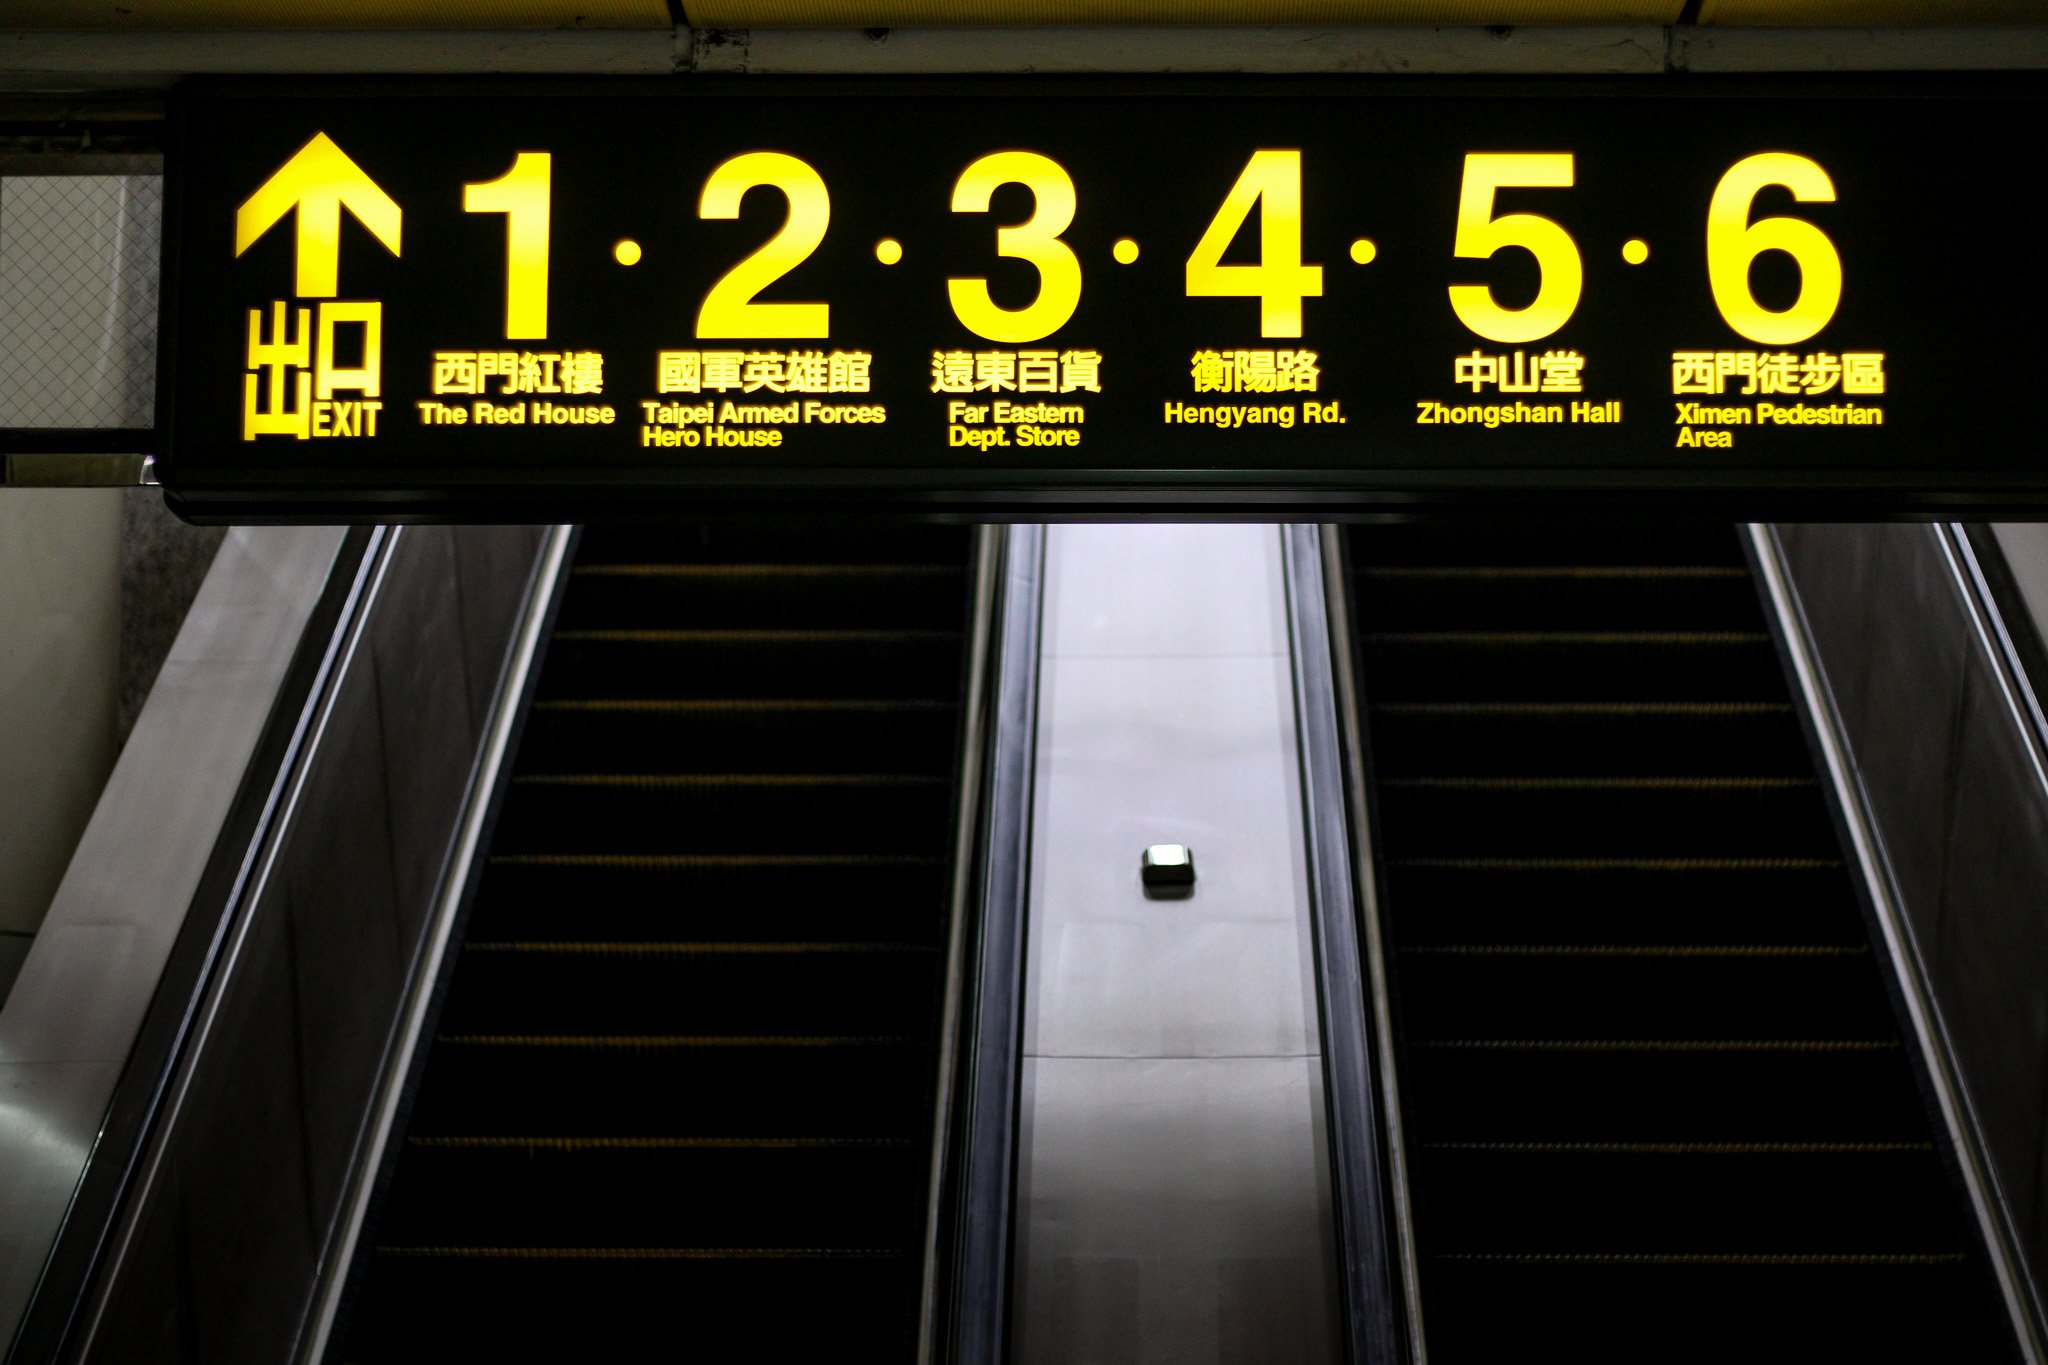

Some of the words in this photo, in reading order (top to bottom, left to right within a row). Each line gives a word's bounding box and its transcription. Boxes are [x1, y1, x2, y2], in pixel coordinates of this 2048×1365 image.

[463, 152, 552, 340] 1
[695, 151, 831, 339] 2
[947, 151, 1082, 343] 3
[1185, 150, 1323, 338] 4
[1448, 153, 1583, 343] 5
[1706, 152, 1843, 345] 6
[244, 300, 382, 441] 出口
[433, 351, 604, 395] 西門紅樓
[657, 350, 873, 394] 國軍英雄館
[930, 350, 1103, 394] 遠東百貨
[1190, 349, 1321, 394] 衡陽路
[1454, 349, 1585, 393] 中山堂
[1672, 351, 1885, 396] 西門徒步區
[312, 402, 382, 437] EXIT
[418, 402, 468, 425] The
[474, 402, 526, 425] Red
[532, 402, 616, 425] House
[642, 401, 714, 430] Taipei
[719, 401, 799, 424] Armed
[804, 401, 887, 424] Forces
[949, 401, 989, 424] Far
[993, 401, 1085, 424] Eastern
[1164, 402, 1295, 429] Hengyang
[1303, 401, 1346, 424] Rd.
[1416, 401, 1563, 429] Zhongshan
[1570, 401, 1621, 424] Hall
[1675, 402, 1752, 425] Ximen
[1757, 402, 1883, 425] Pedestrian
[643, 425, 701, 448] Hero
[705, 425, 783, 448] House
[949, 425, 1011, 452] Dept.
[1015, 425, 1081, 448] Store
[1675, 426, 1733, 448] Area
